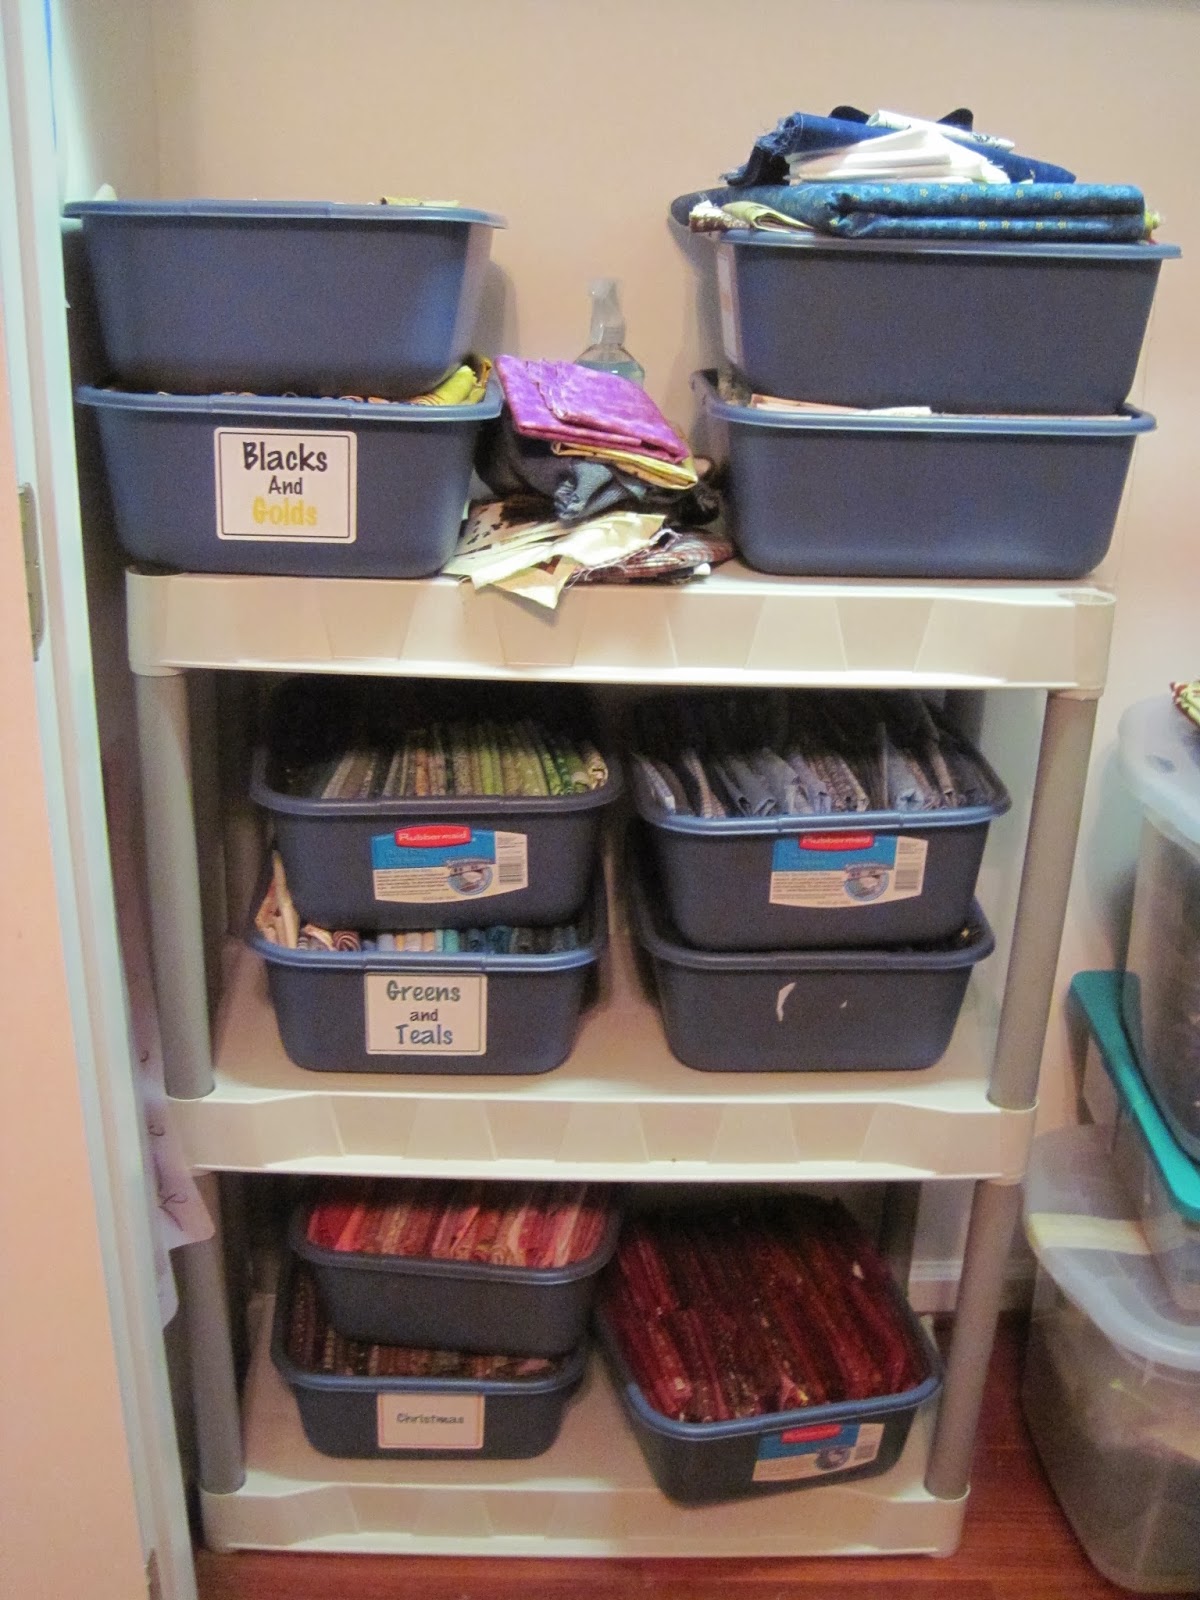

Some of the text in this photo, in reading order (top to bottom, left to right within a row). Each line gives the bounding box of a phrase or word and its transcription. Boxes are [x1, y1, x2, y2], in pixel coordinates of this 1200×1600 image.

[243, 441, 328, 472] Blacks
[268, 475, 303, 495] And
[252, 496, 318, 526] Golds
[386, 980, 461, 1001] Greens
[410, 1009, 438, 1021] and
[396, 1024, 454, 1045] Teals
[396, 1412, 464, 1424] Christmas
